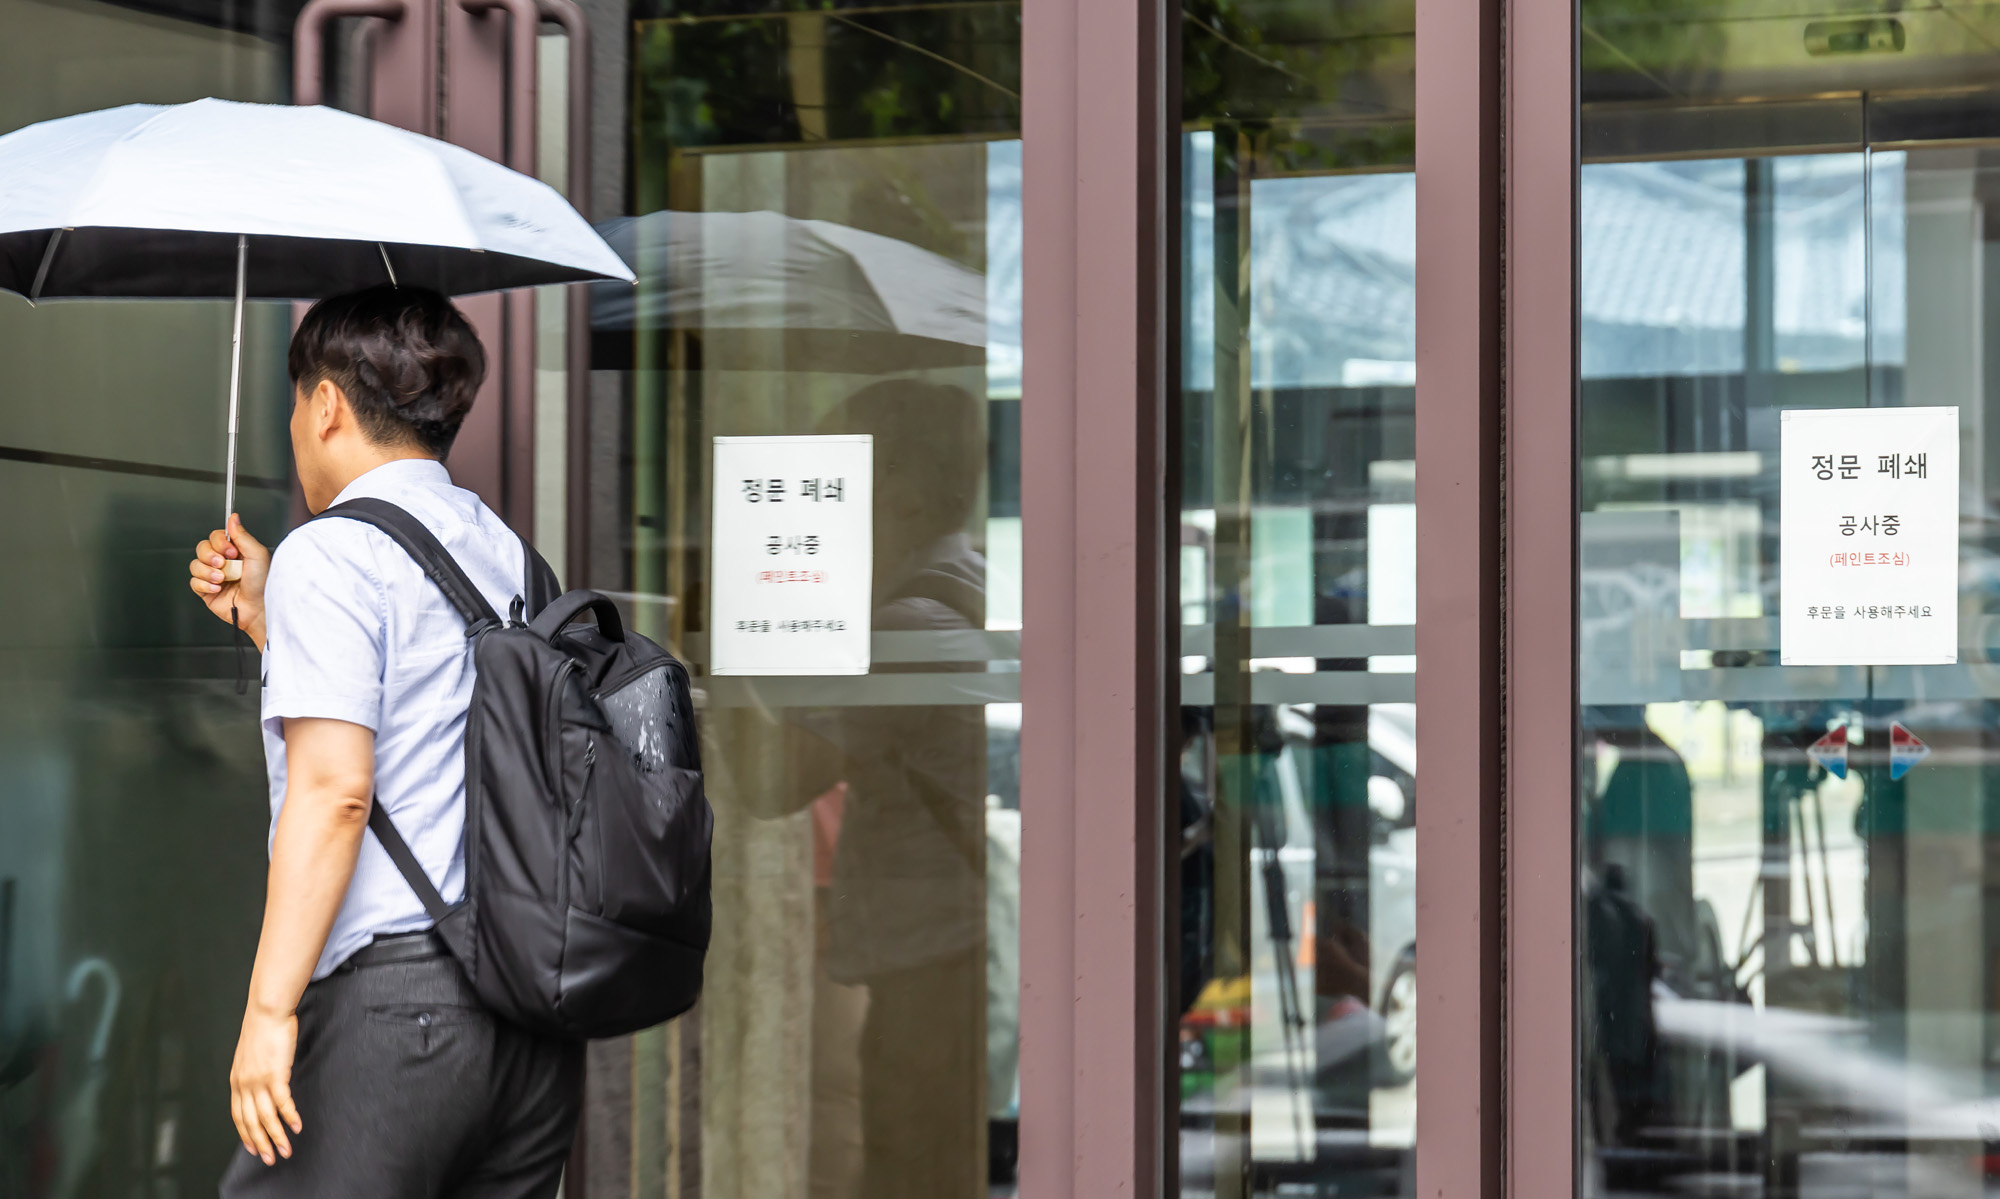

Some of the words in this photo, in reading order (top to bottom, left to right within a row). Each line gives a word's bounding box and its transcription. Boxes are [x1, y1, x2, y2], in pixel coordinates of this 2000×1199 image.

[1811, 453, 1862, 481] 정문
[1877, 452, 1928, 480] 폐쇄
[741, 477, 787, 503] 정문
[799, 477, 846, 503] 폐쇄
[1838, 514, 1901, 537] 공사중
[765, 535, 821, 556] 공사중
[1829, 551, 1911, 568] (페인트조심)
[1806, 605, 1847, 620] 후문을
[1853, 605, 1933, 620] 사용해주세요
